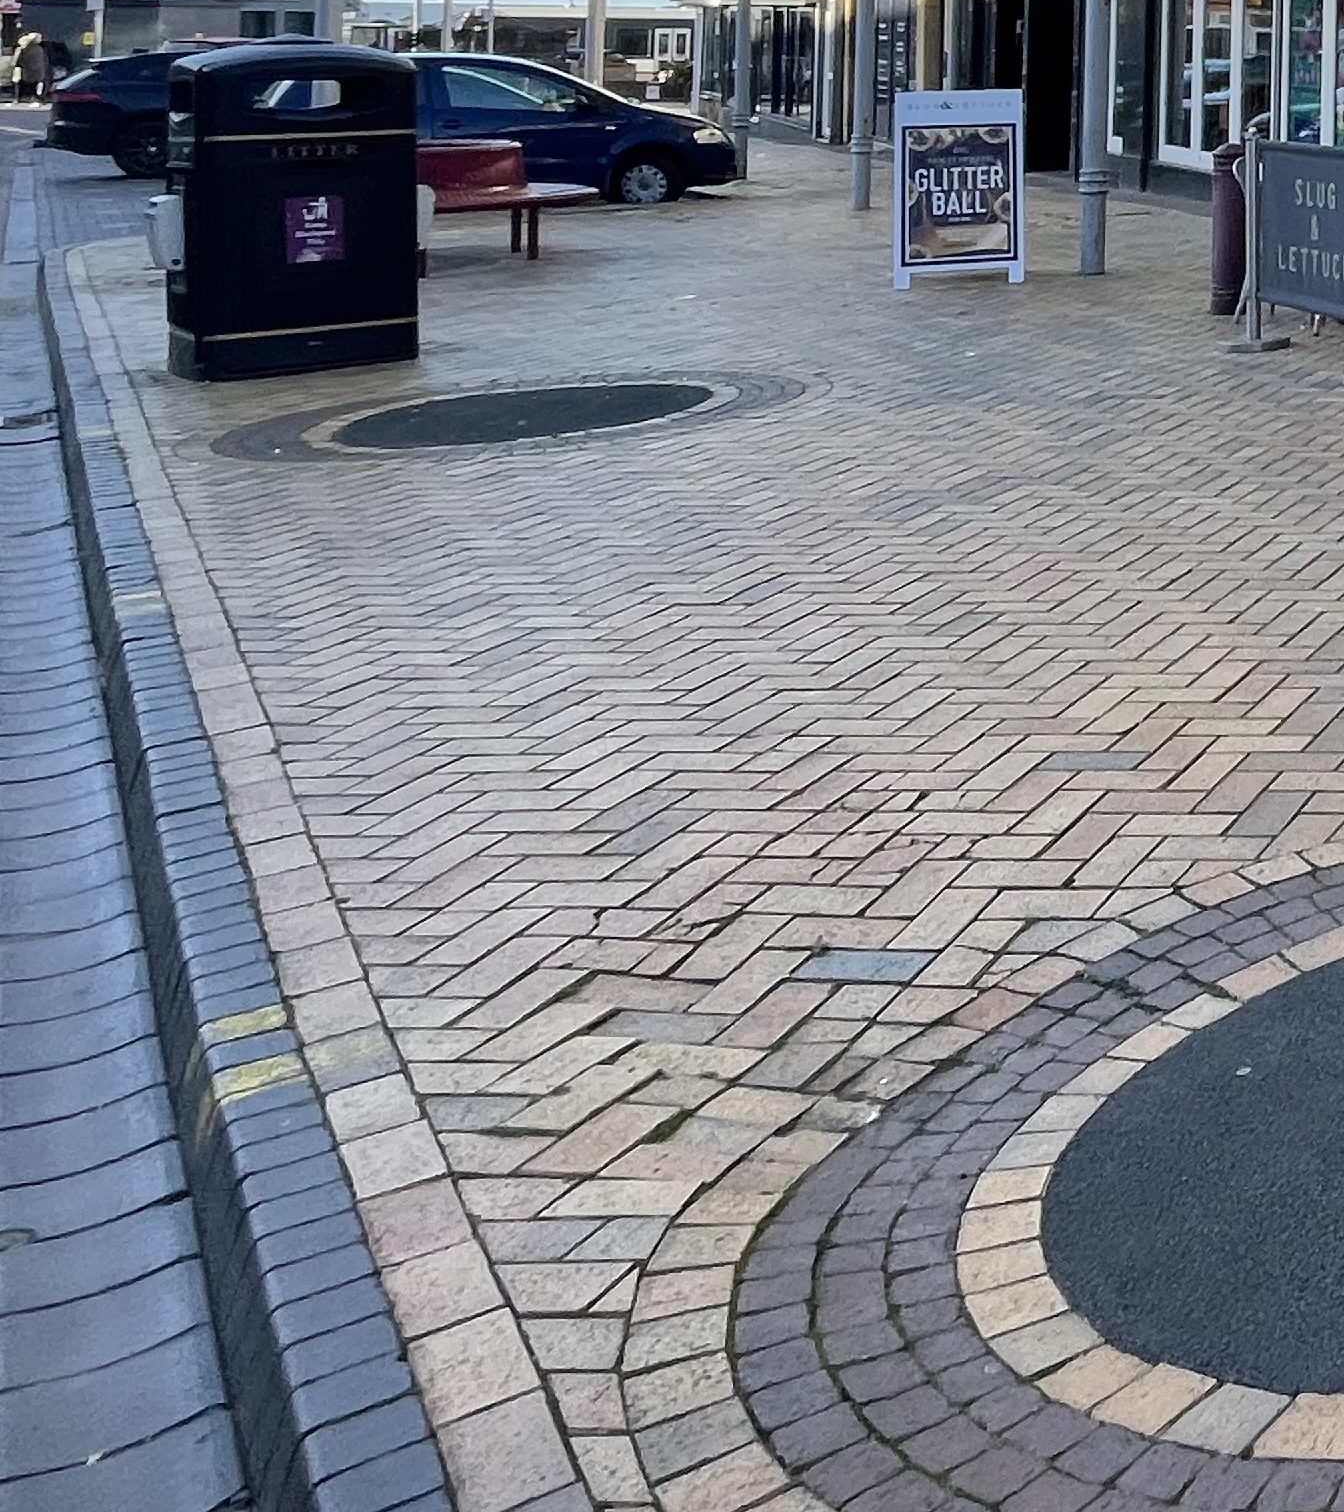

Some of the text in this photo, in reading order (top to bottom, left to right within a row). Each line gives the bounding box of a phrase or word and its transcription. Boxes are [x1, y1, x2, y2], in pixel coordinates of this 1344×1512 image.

[915, 165, 1004, 192] GLITTER
[932, 190, 987, 216] BALL
[1294, 178, 1336, 210] SLUG
